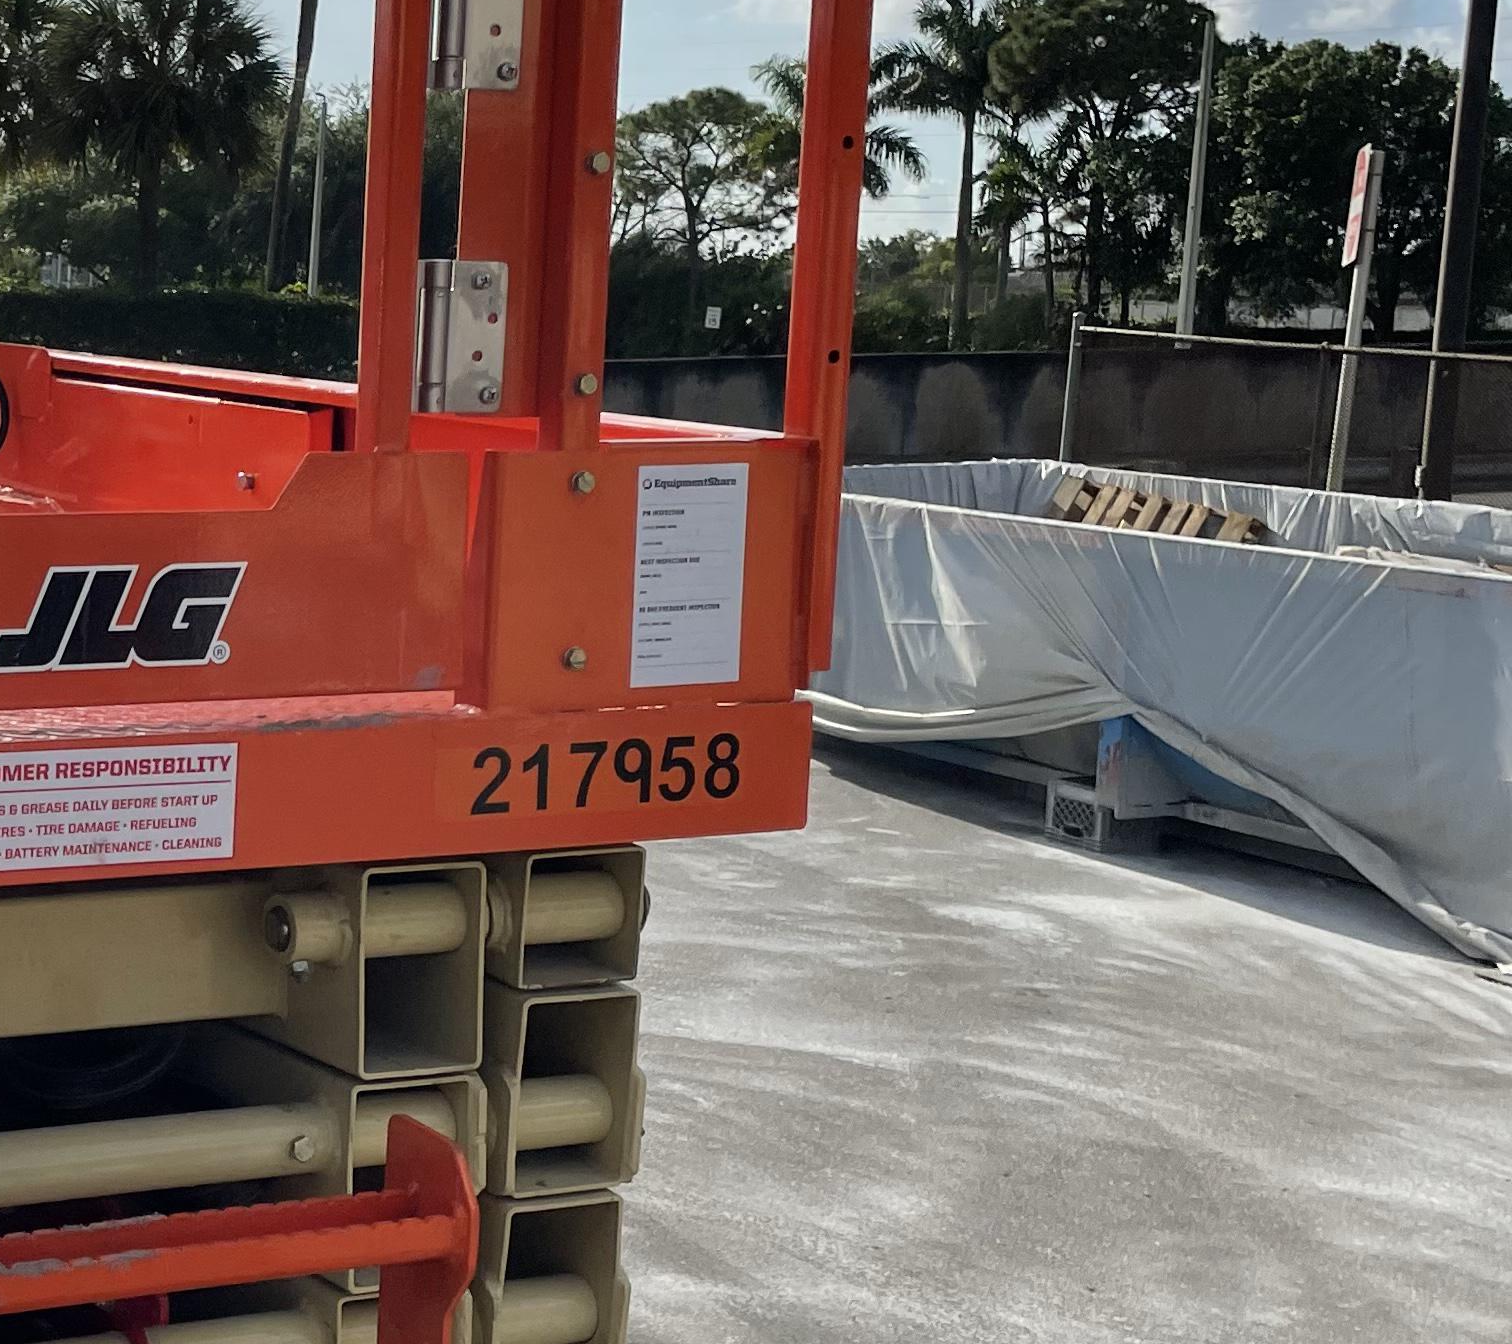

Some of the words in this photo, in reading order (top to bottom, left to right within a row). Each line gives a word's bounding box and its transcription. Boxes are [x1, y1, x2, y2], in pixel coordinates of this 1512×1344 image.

[654, 478, 737, 489] EquipmentShare
[55, 755, 232, 780] RESPONSIBILITY
[470, 732, 740, 816] 217958
[9, 803, 18, 815] &
[22, 801, 69, 815] GREASE
[73, 799, 110, 812] DAILY
[111, 797, 157, 810] BEFORE
[161, 795, 199, 807] START
[202, 794, 218, 806] UP
[36, 824, 64, 836] TIRE
[68, 821, 120, 834] DAMAGE
[130, 817, 197, 831] REFUELING
[5, 845, 59, 860] BATTERY
[62, 840, 152, 856] MAINTENANCE
[162, 837, 222, 850] CLEANING
